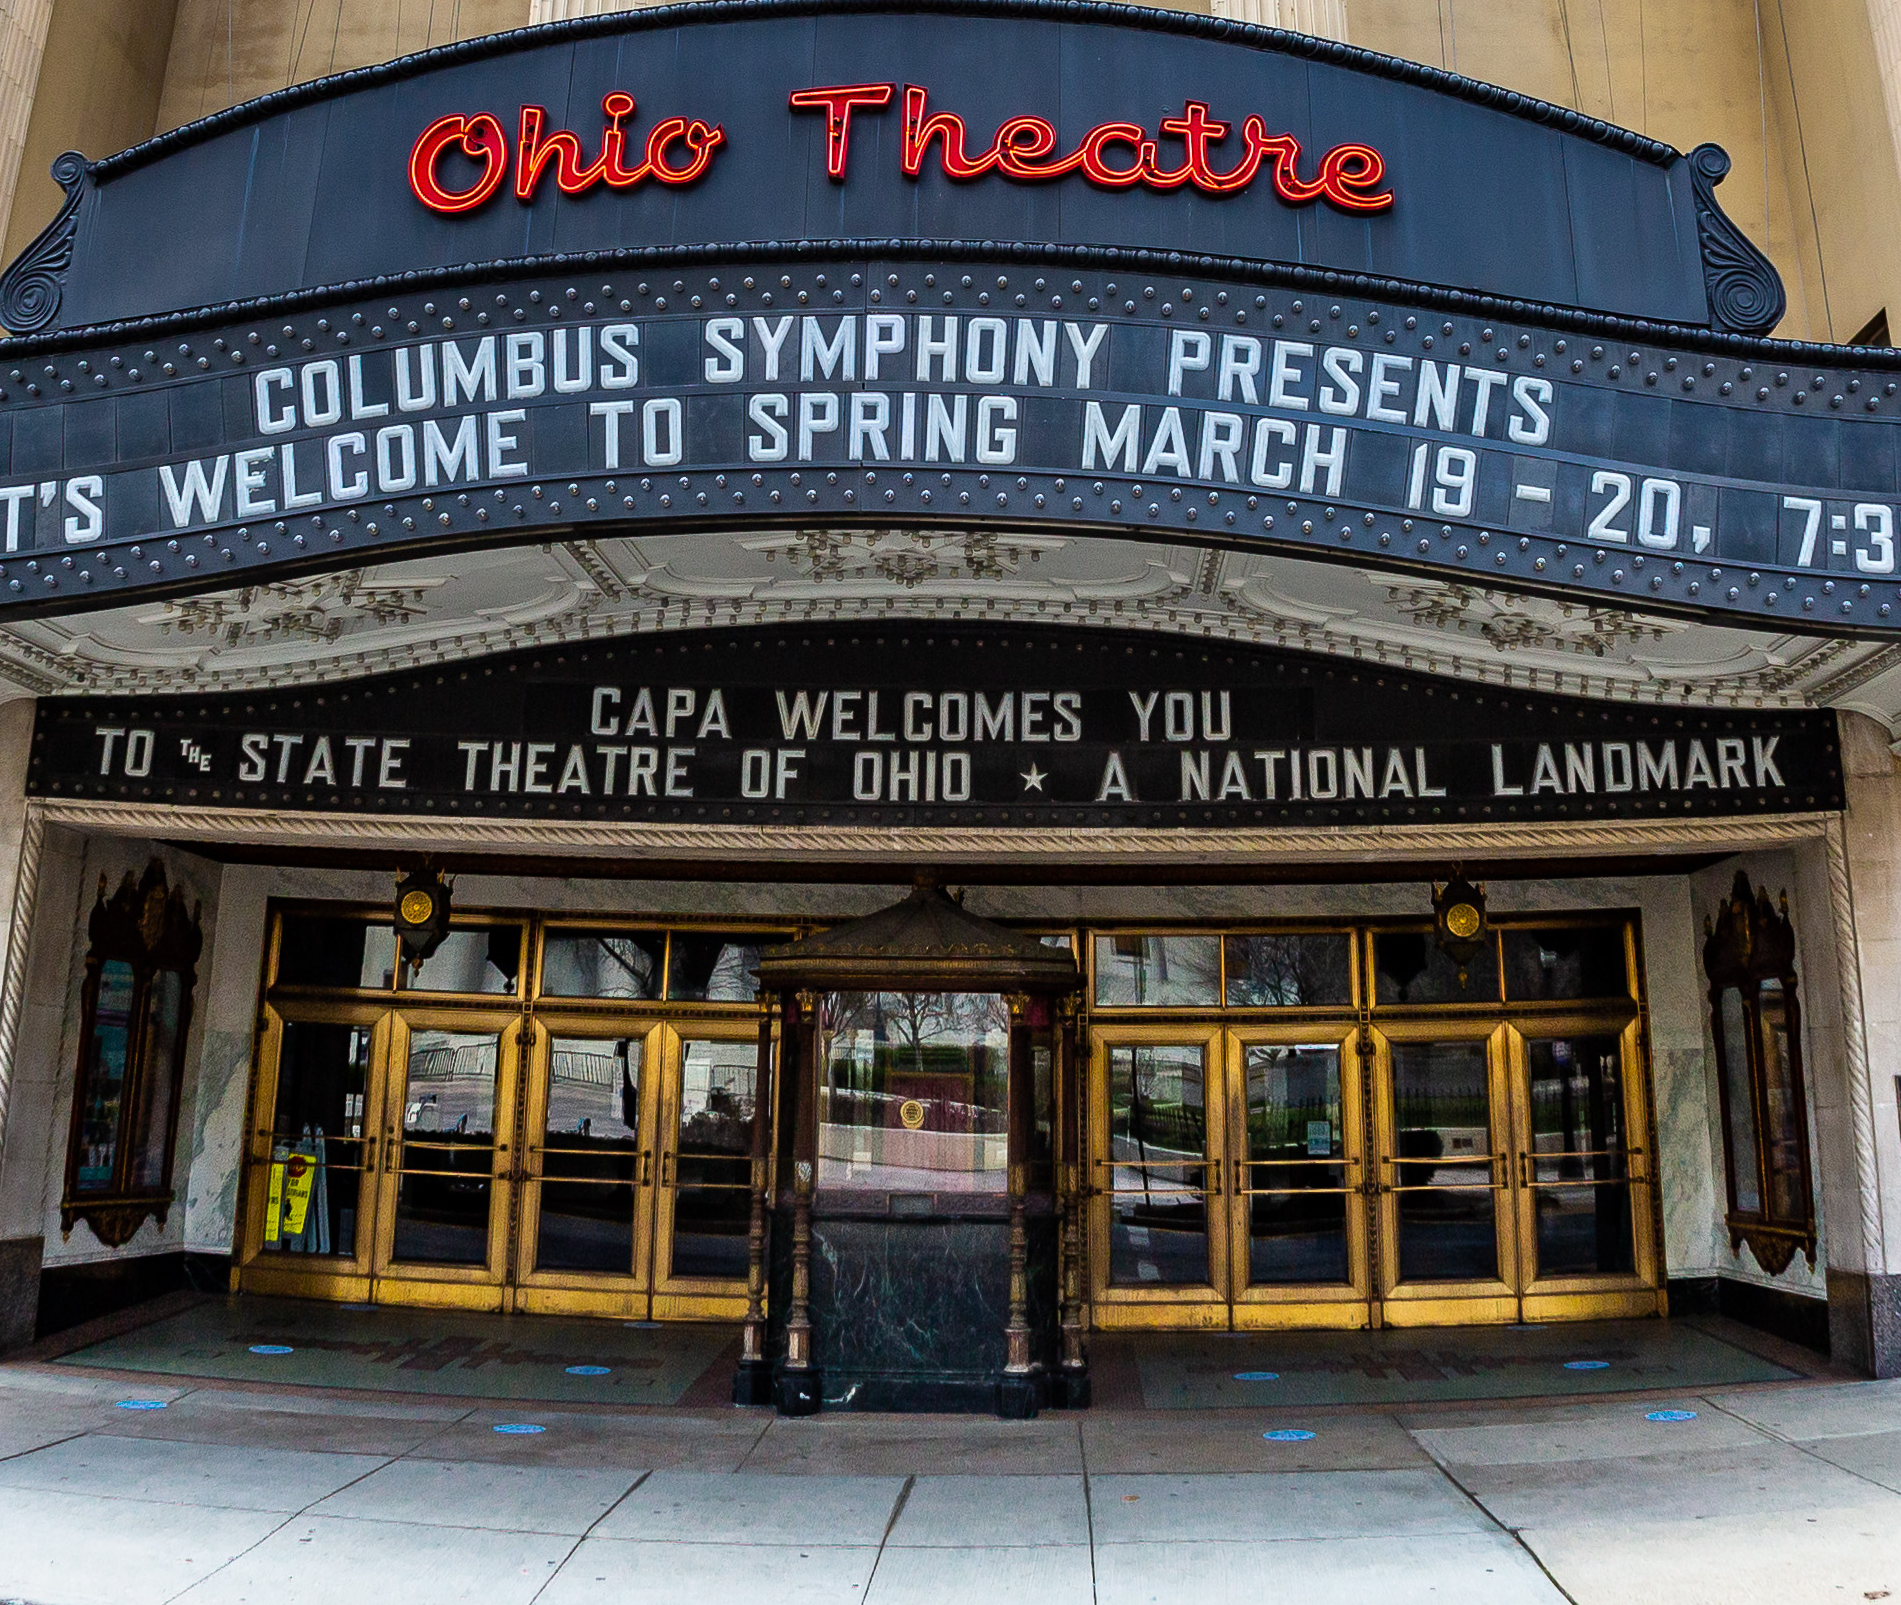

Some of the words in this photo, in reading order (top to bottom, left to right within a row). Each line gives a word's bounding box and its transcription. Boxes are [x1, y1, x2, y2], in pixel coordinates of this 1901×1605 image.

[406, 92, 724, 214] Ohio
[789, 83, 1394, 211] Theatre
[254, 322, 642, 439] COLUMBUS
[703, 312, 1111, 388] SYMPHONY
[1166, 327, 1555, 449] PRESENTS
[157, 407, 529, 529] WELCOME
[588, 396, 684, 471] TO
[747, 390, 1019, 466] SPRING
[1080, 398, 1351, 495] MARCH
[1407, 441, 1478, 518] 19
[1586, 469, 1712, 556] 20,
[94, 727, 155, 778] TO
[238, 733, 411, 789] STATE
[456, 741, 697, 798] THEATRE
[740, 748, 807, 800] OF
[852, 750, 972, 803] OHIO
[1094, 752, 1134, 803] A
[1180, 746, 1448, 802] NATIONAL
[1491, 735, 1786, 797] LANDMARK
[590, 686, 732, 740] CAPA
[775, 690, 1082, 743] WELCOMES
[1127, 690, 1232, 743] YOU
